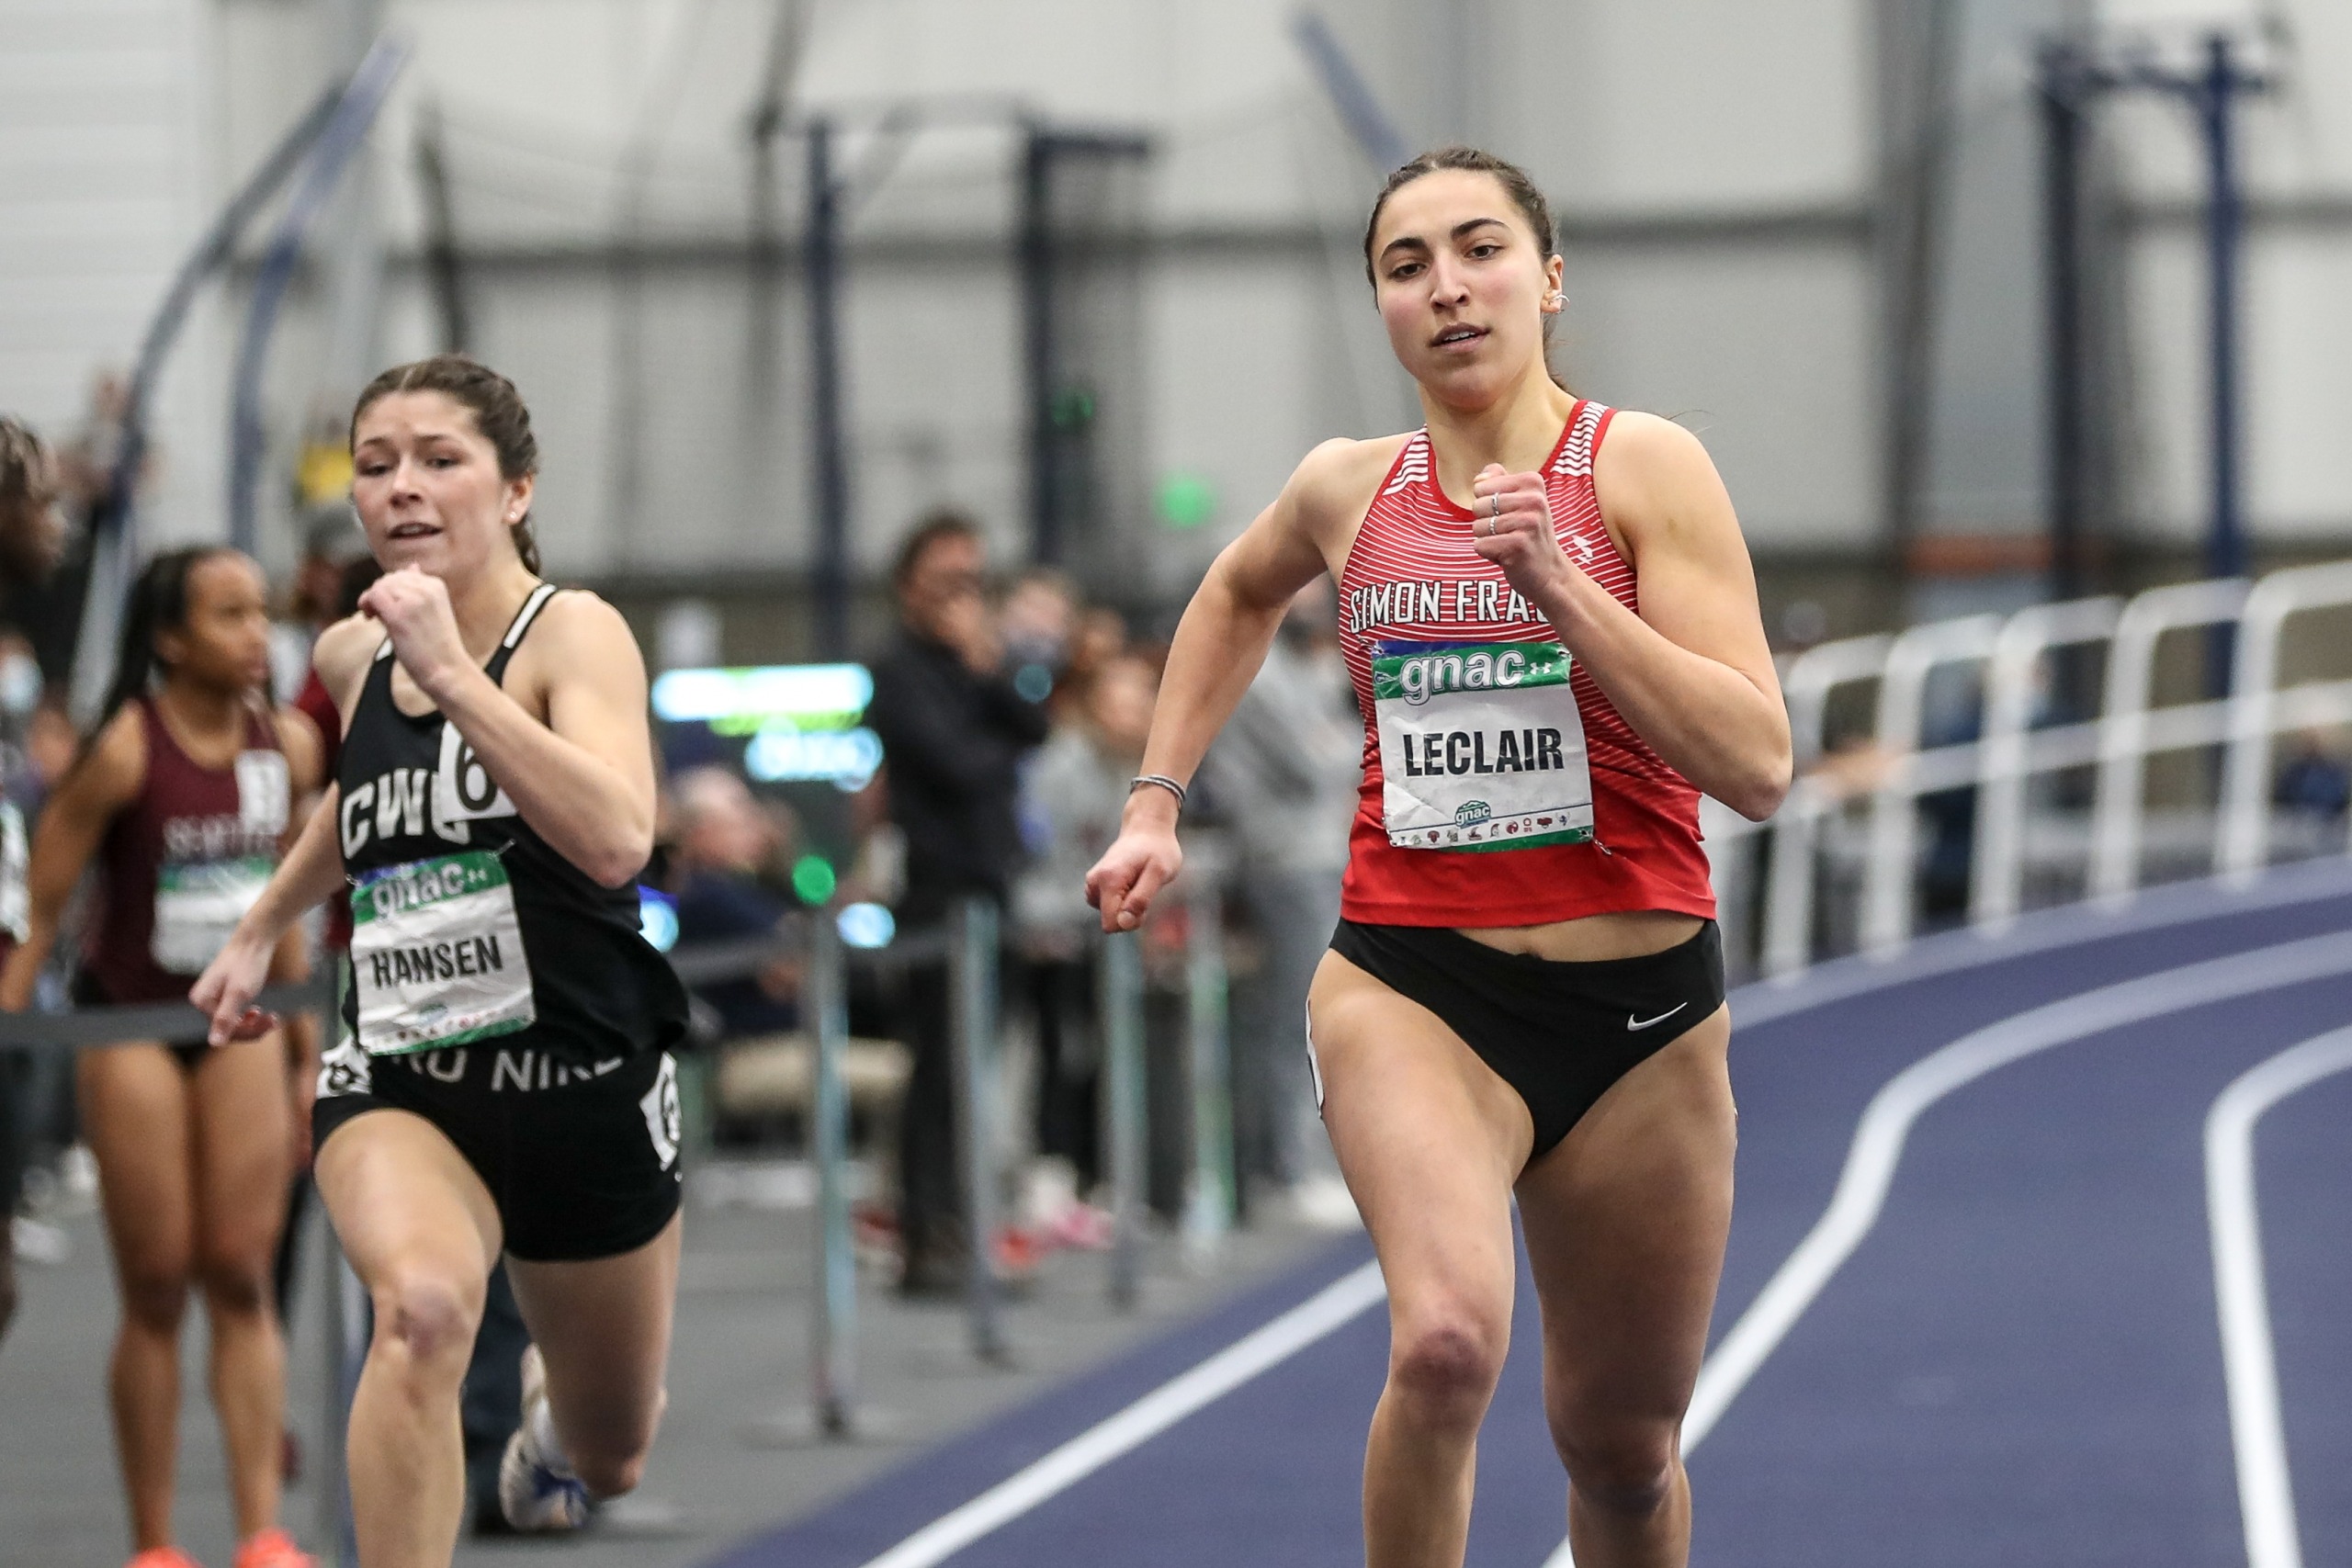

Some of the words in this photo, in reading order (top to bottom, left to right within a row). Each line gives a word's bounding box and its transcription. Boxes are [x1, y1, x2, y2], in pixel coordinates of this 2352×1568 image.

[1350, 580, 1442, 634] SIMON
[1456, 579, 1551, 624] FRA
[1400, 649, 1525, 705] gnac
[1402, 728, 1565, 777] LECLAIR
[1455, 806, 1490, 827] gnac
[371, 863, 465, 921] gnac
[369, 935, 504, 990] HANSEN
